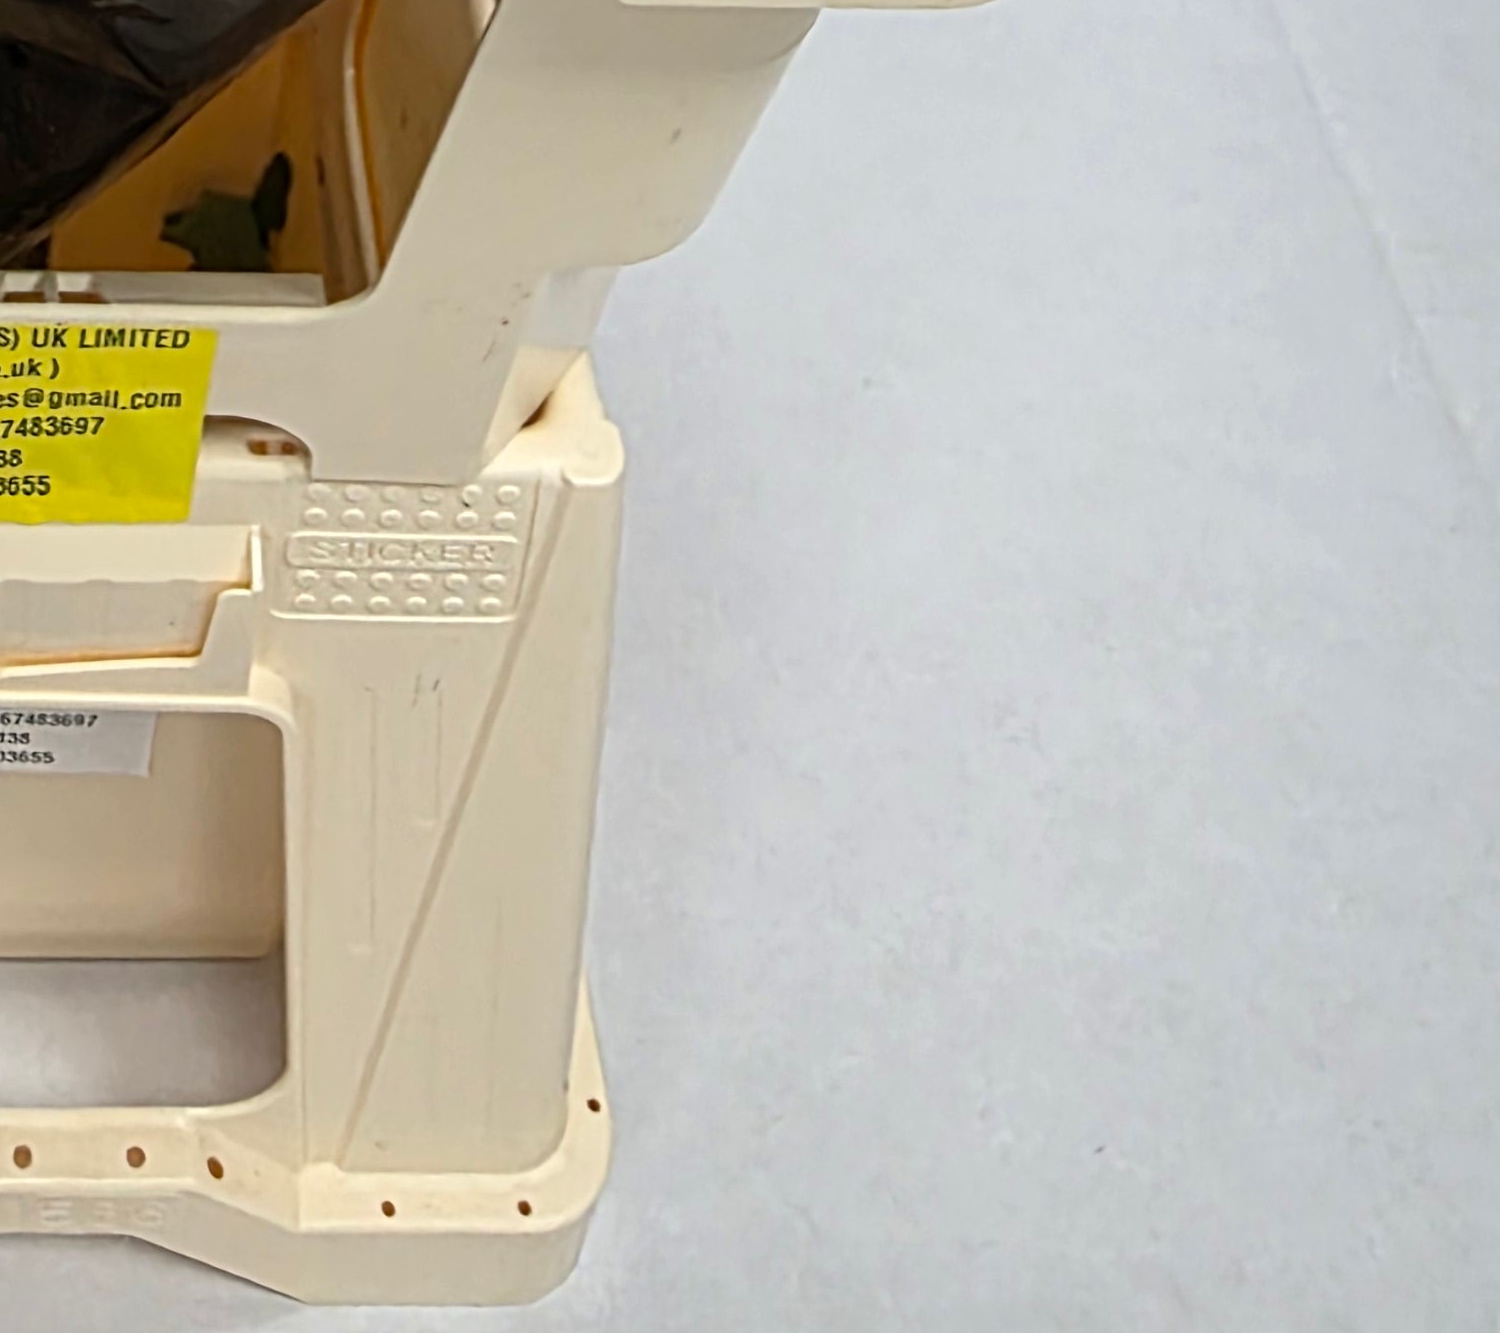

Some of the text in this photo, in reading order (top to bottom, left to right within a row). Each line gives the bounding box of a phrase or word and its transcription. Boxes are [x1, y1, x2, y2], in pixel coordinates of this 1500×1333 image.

[32, 326, 68, 348] UK
[78, 328, 191, 349] LIMITED
[307, 540, 496, 566] STICKER
